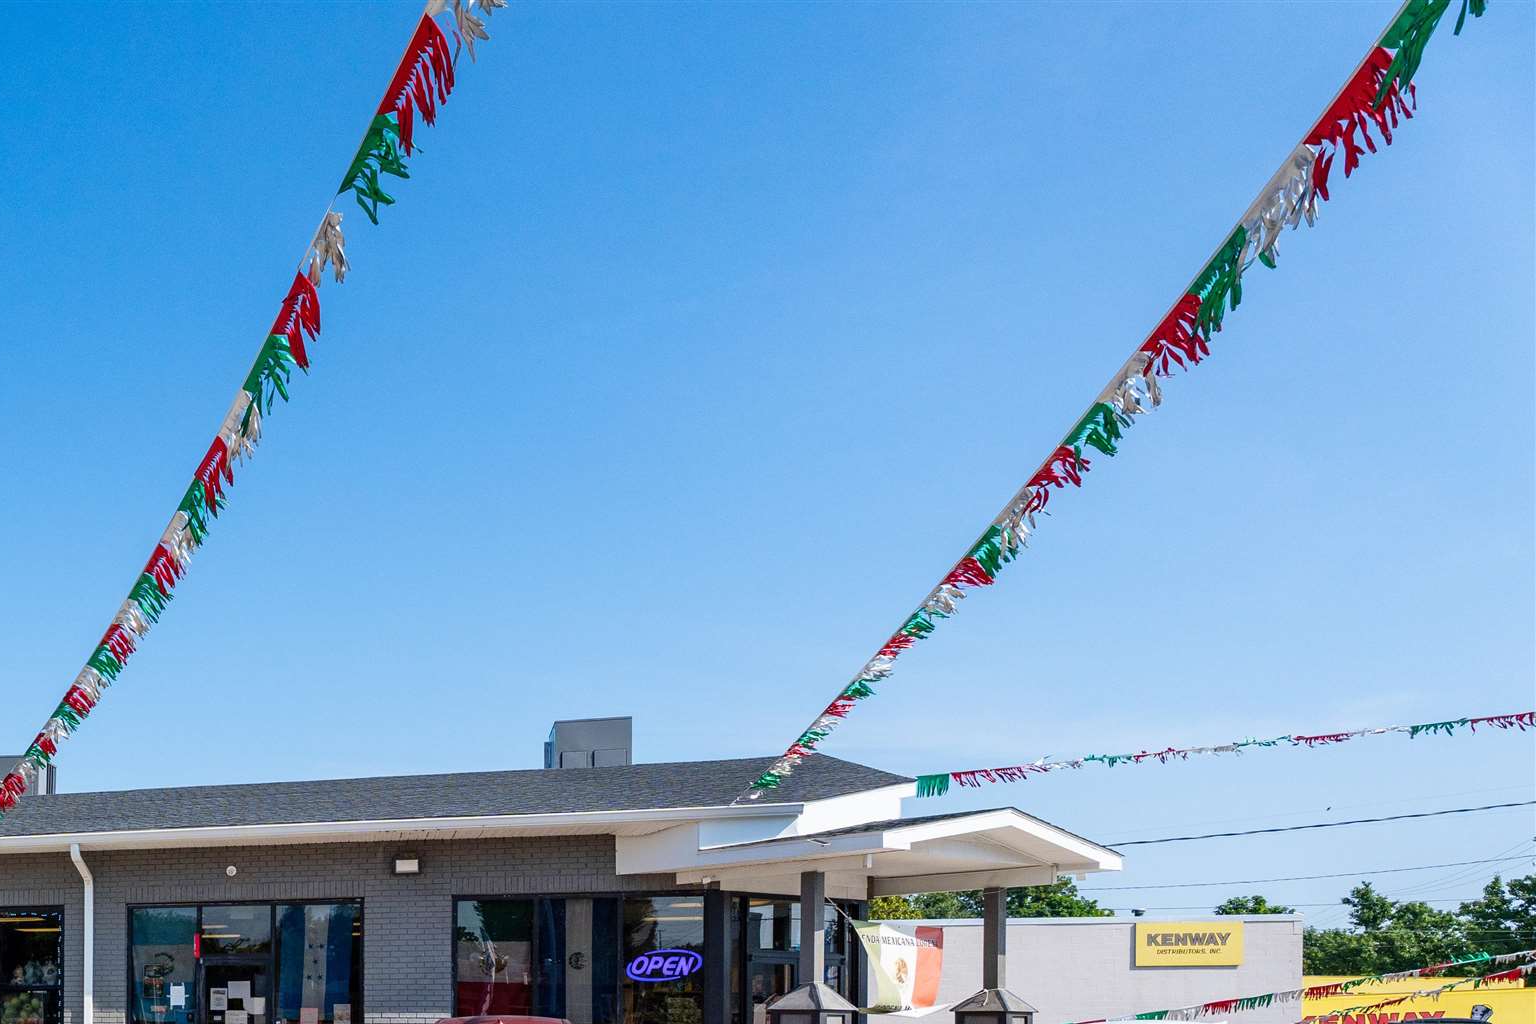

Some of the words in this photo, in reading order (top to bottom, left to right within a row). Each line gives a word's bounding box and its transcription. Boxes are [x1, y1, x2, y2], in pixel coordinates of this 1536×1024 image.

[881, 935, 915, 947] MEXICANA
[1146, 932, 1231, 946] KENWAY
[631, 955, 694, 976] OPEN
